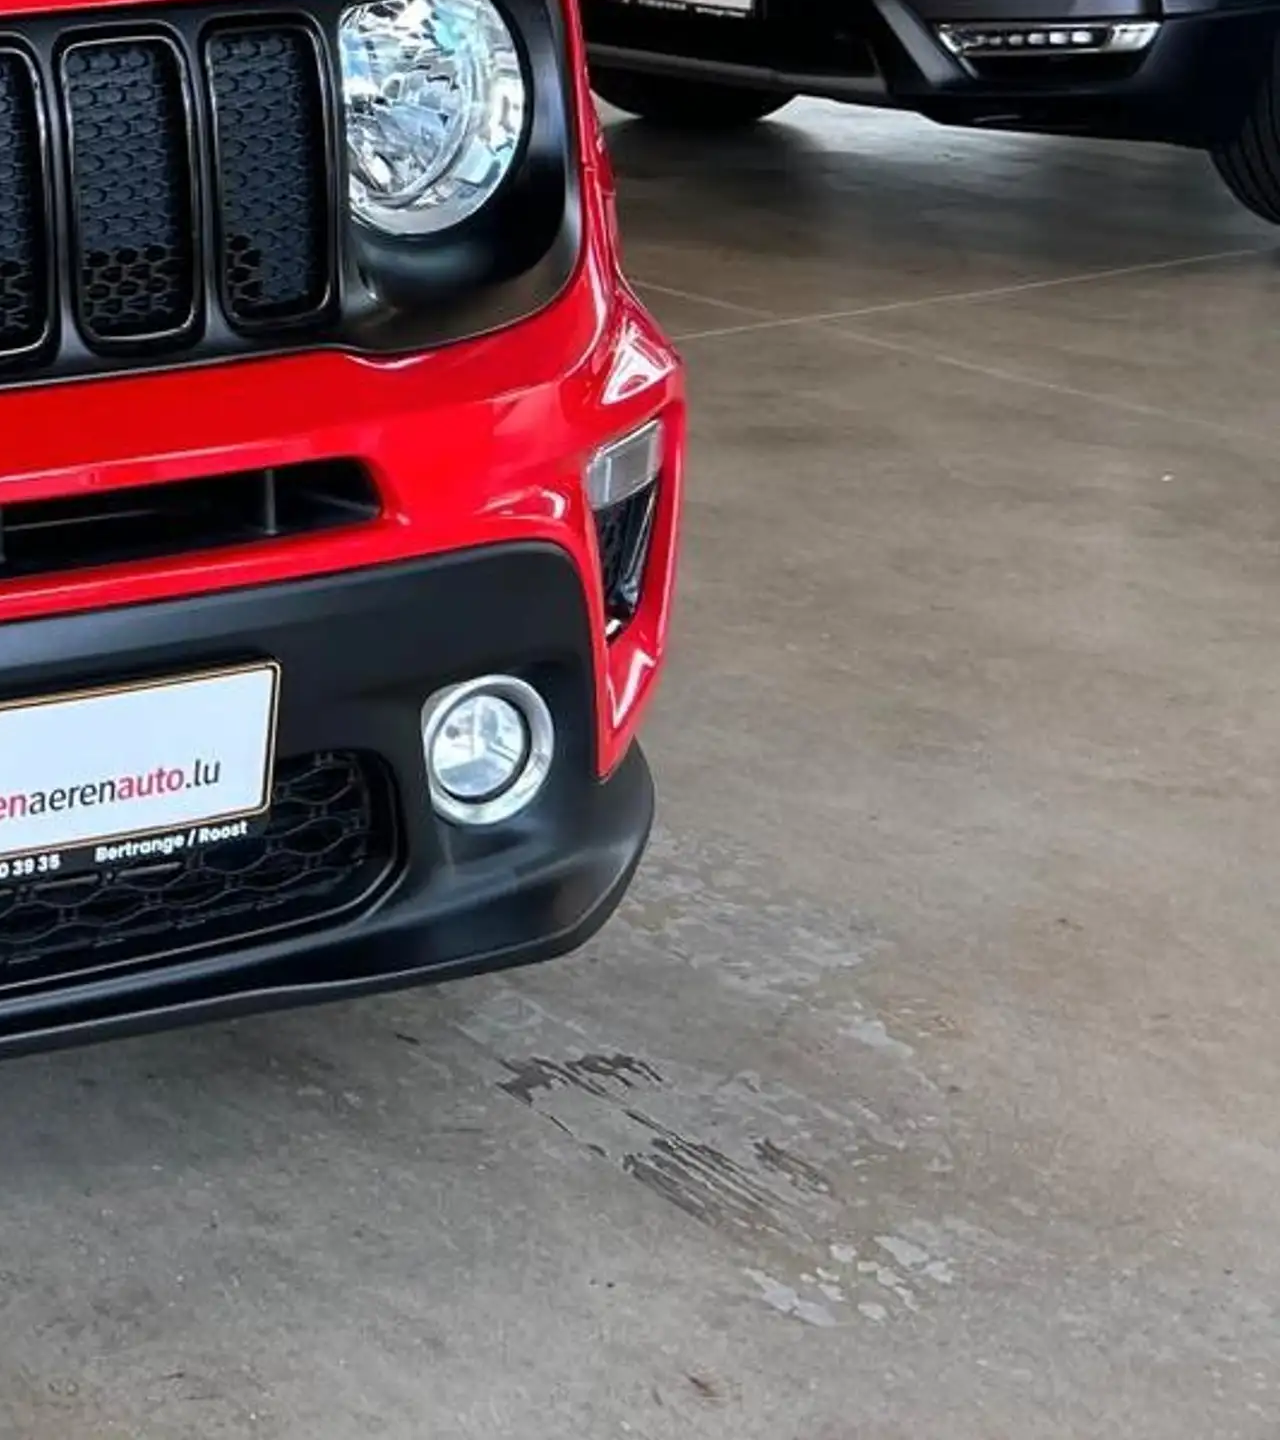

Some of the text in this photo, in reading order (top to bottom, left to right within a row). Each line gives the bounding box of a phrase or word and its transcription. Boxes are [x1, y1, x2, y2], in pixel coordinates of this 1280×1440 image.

[95, 834, 185, 862] Bertrange
[200, 821, 248, 843] Roost
[13, 859, 33, 876] 39
